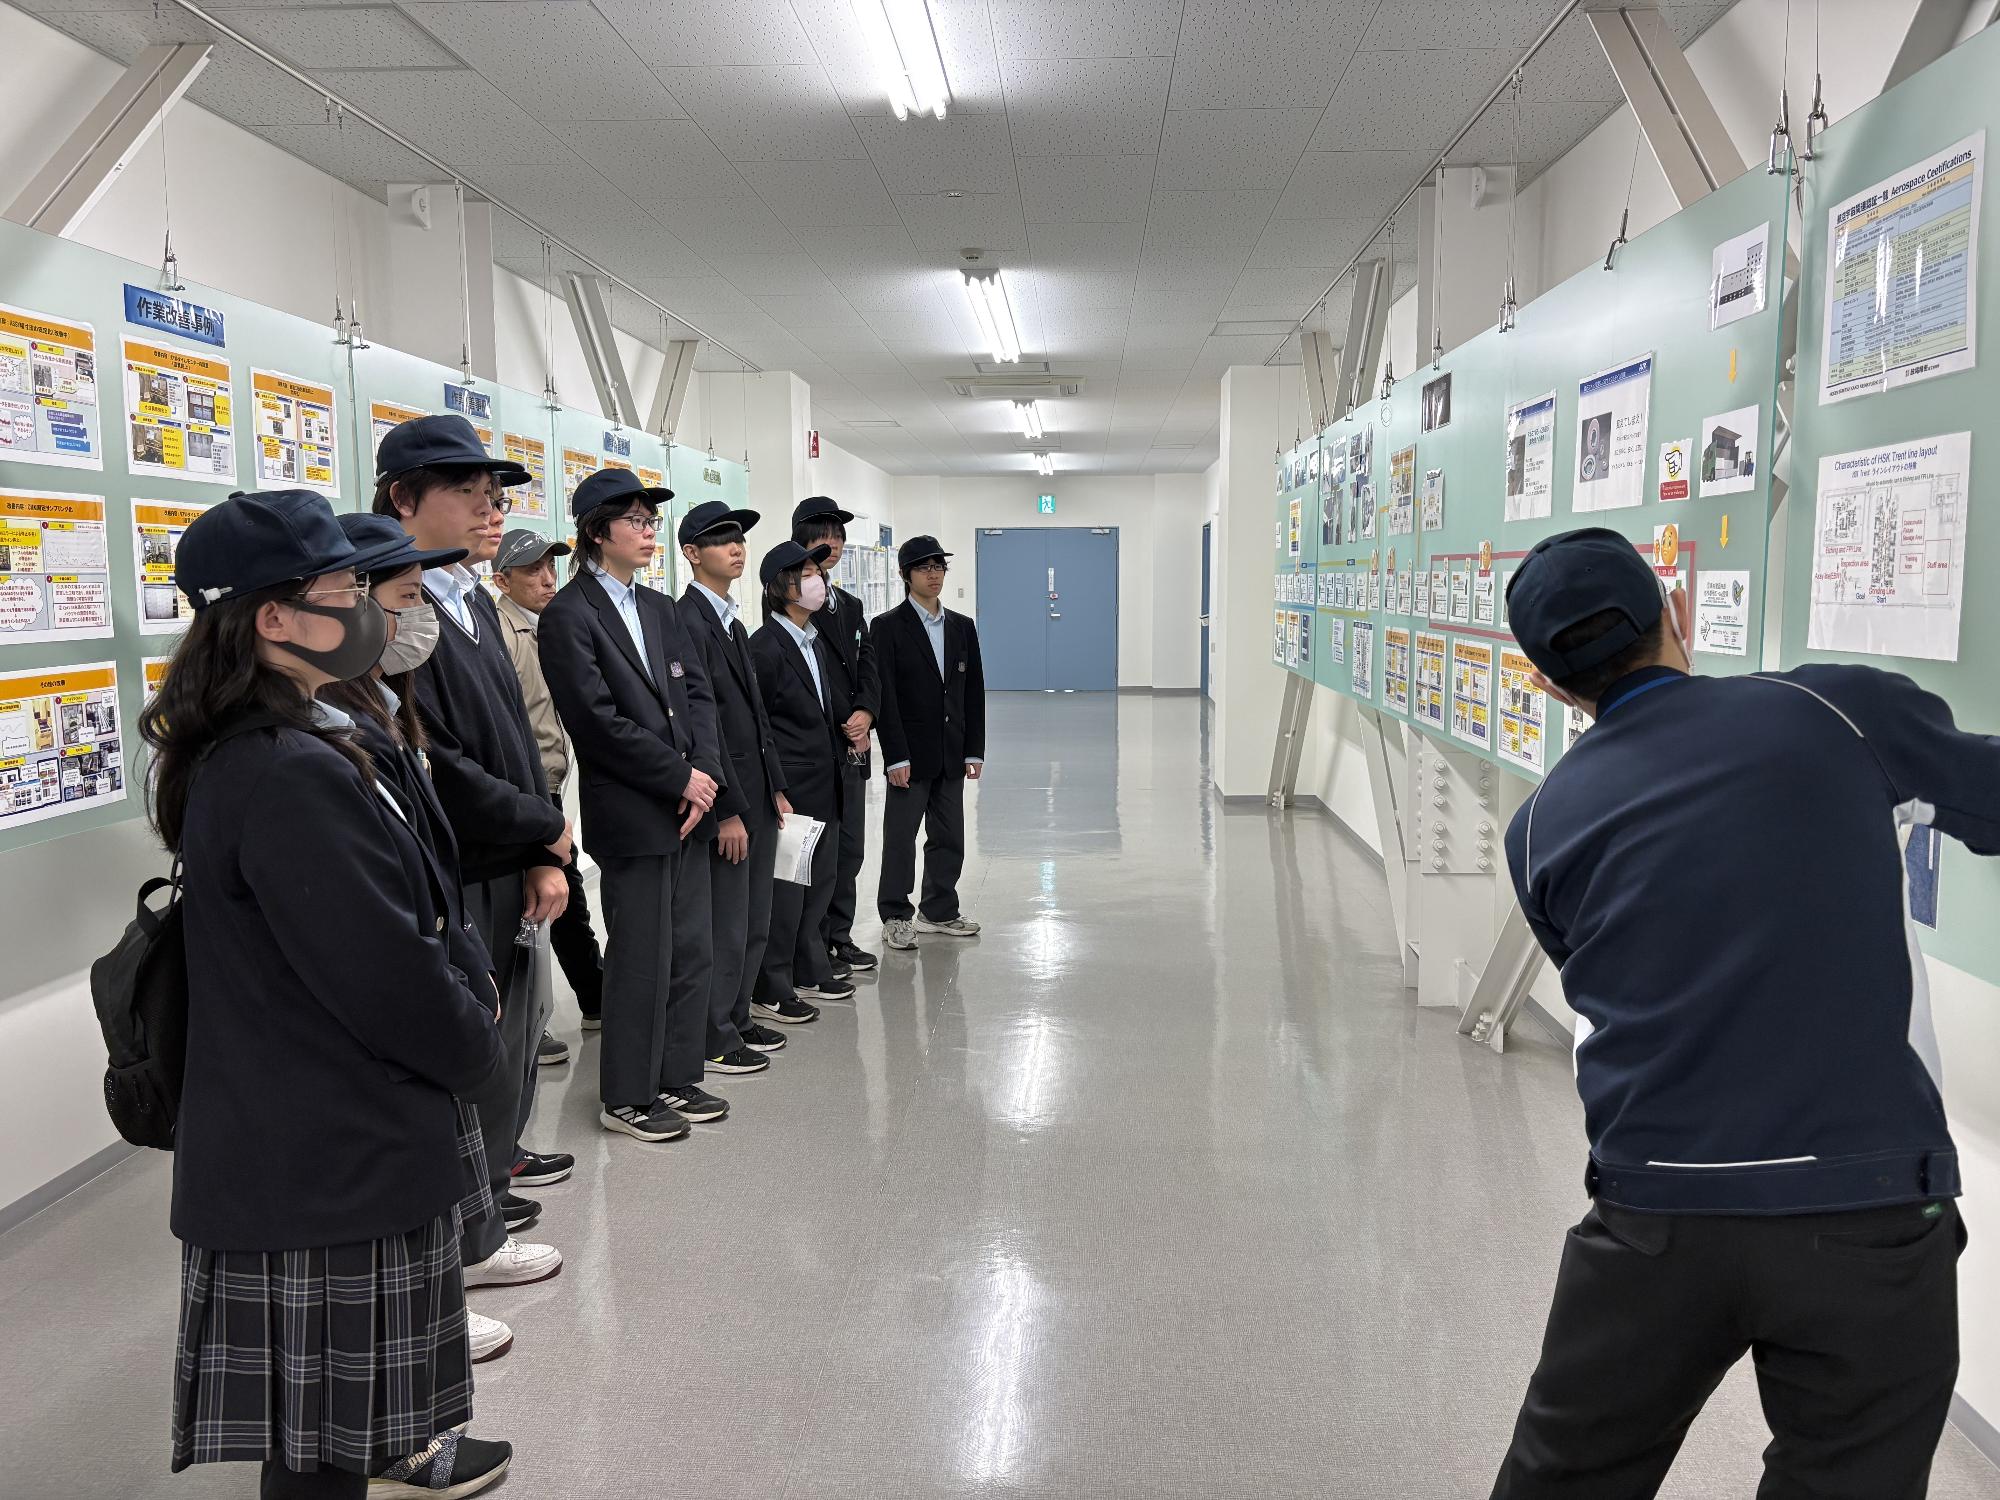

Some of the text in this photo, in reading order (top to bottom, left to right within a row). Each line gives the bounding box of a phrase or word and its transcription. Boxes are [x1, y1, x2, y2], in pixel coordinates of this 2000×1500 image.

[1890, 175, 1926, 197] Aerospace
[137, 296, 215, 337] 作業改善事例
[1834, 456, 1870, 471] Characteristic
[1870, 455, 1877, 464] of
[1877, 452, 1891, 464] HSK
[1891, 450, 1907, 461] Trent
[1919, 444, 1938, 460] layout
[1855, 592, 1866, 600] Goal
[1876, 595, 1887, 604] Start
